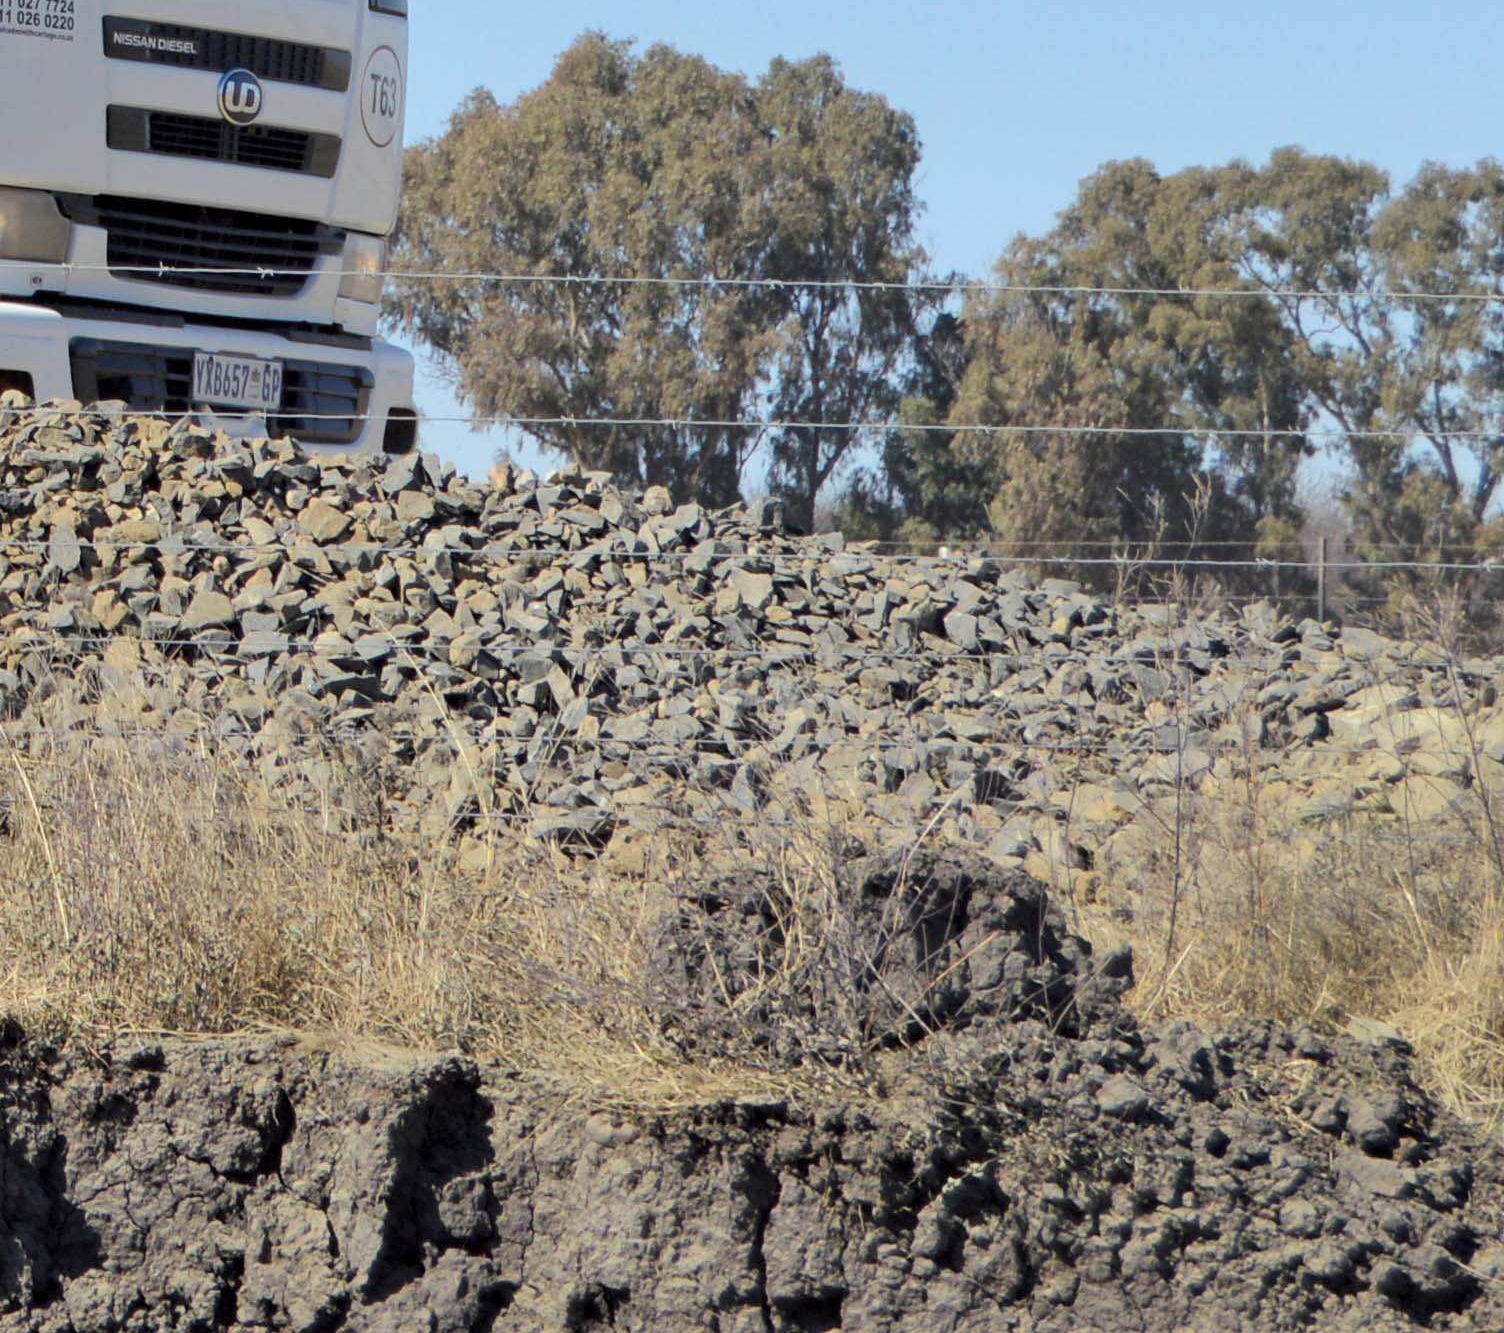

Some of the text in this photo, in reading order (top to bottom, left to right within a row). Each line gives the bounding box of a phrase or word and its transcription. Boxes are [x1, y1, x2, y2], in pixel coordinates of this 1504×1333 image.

[16, 10, 41, 27] 026
[44, 13, 75, 31] 0220
[113, 32, 198, 54] NISSAN DIESEL
[226, 80, 261, 114] UD
[370, 72, 398, 118] T63
[262, 364, 281, 403] GP
